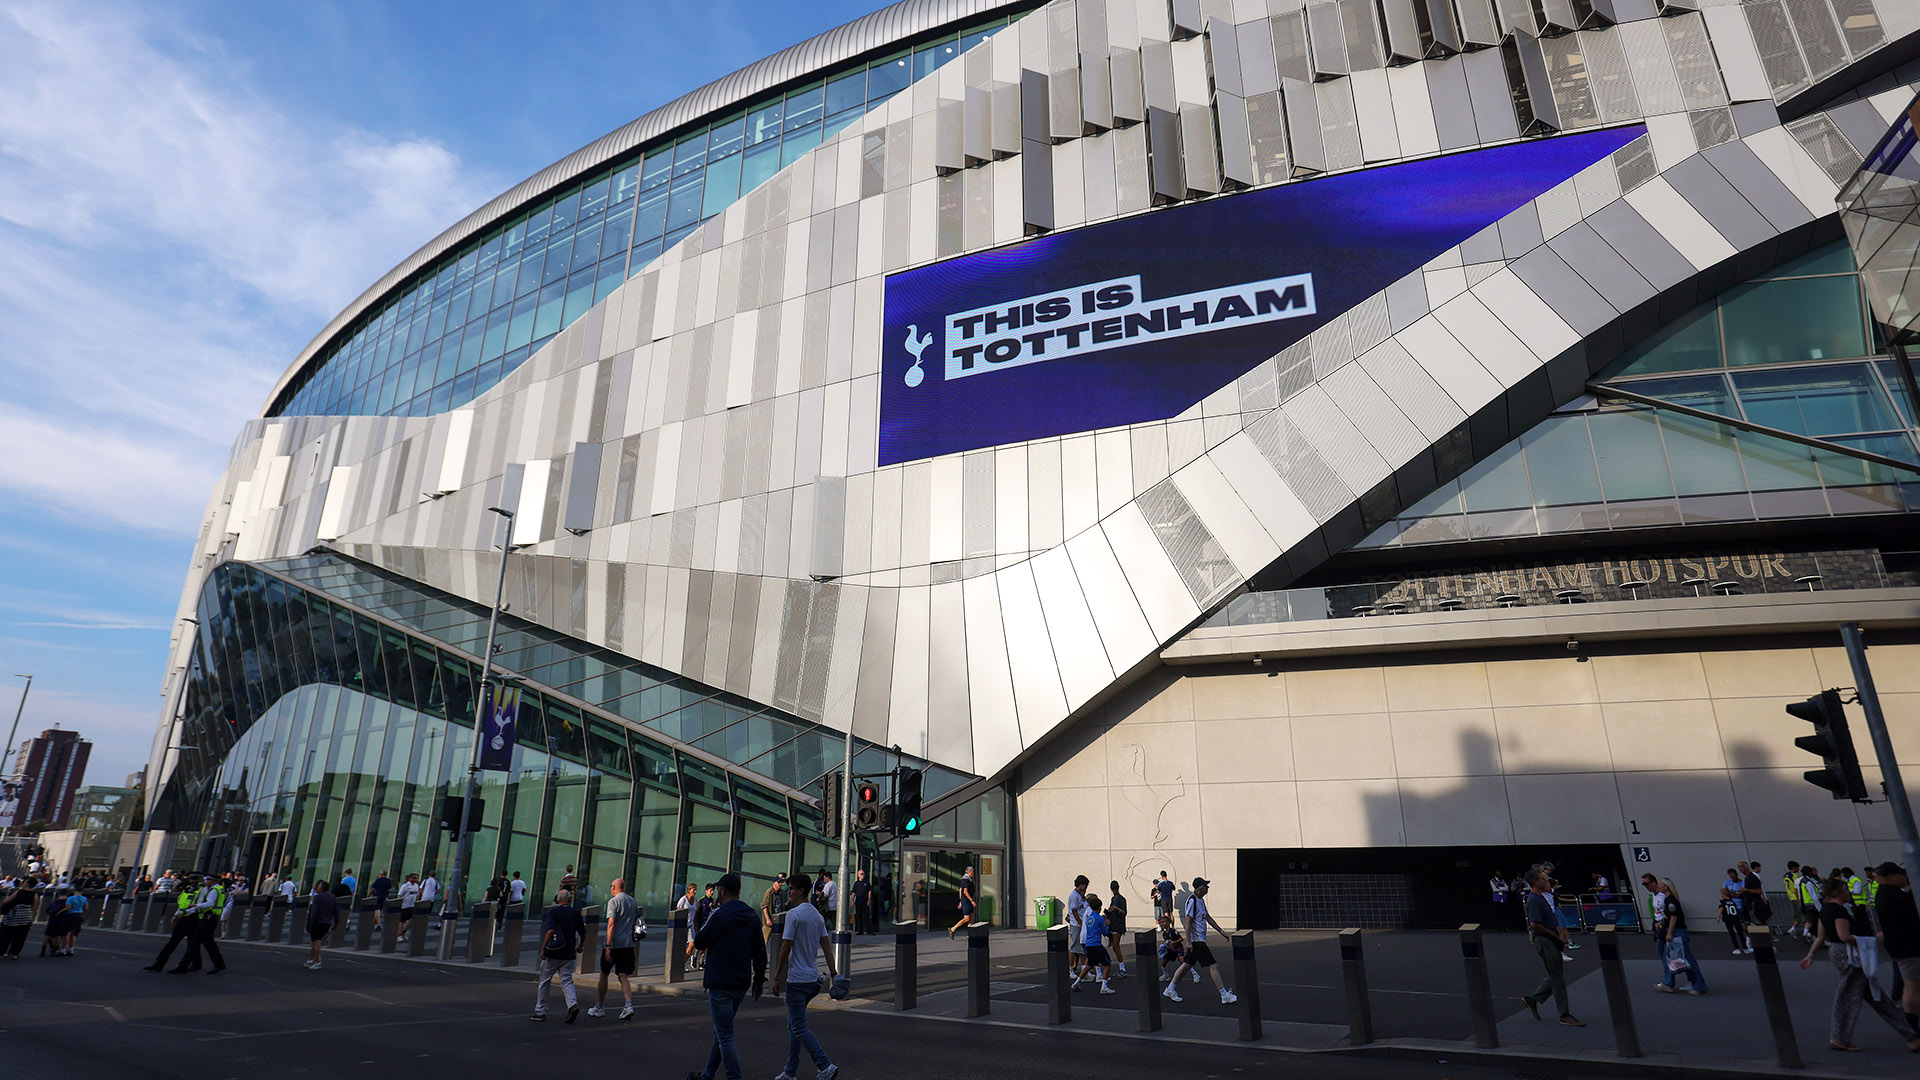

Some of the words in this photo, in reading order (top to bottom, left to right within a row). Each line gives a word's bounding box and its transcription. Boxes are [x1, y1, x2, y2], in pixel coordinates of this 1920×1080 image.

[952, 297, 1070, 339] THIS
[1081, 284, 1135, 315] IS
[952, 284, 1307, 371] TOTTENHAM
[1601, 548, 1792, 585] HOTSPUR
[1630, 820, 1640, 834] 1
[1724, 904, 1737, 916] 10
